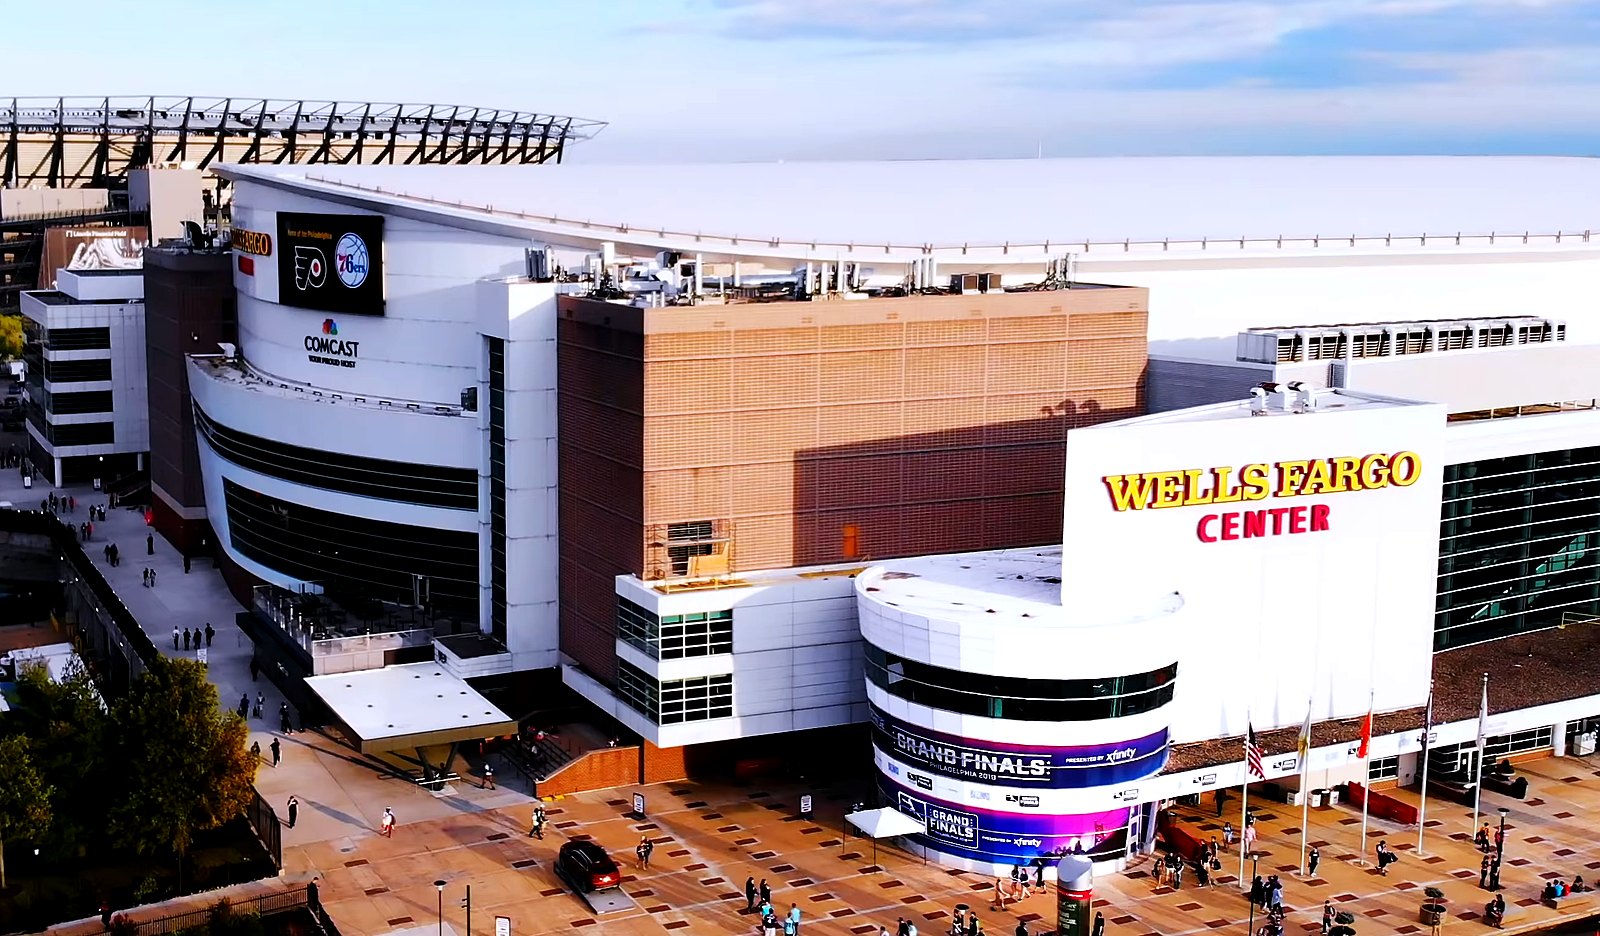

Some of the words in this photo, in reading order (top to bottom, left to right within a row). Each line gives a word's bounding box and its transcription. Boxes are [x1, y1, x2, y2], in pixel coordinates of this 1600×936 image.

[338, 254, 366, 274] 76ers
[304, 335, 359, 357] COMCAST
[340, 359, 356, 368] HOST
[1102, 463, 1269, 511] WELLS
[1273, 450, 1422, 498] FARGO
[1196, 504, 1331, 543] CENTER
[897, 732, 956, 764] GRAND
[1106, 747, 1137, 764] xfinity
[930, 761, 977, 778] PHILADELPHIA
[930, 818, 974, 838] FINALS
[932, 809, 969, 827] GRAND
[1013, 837, 1042, 848] xfinity
